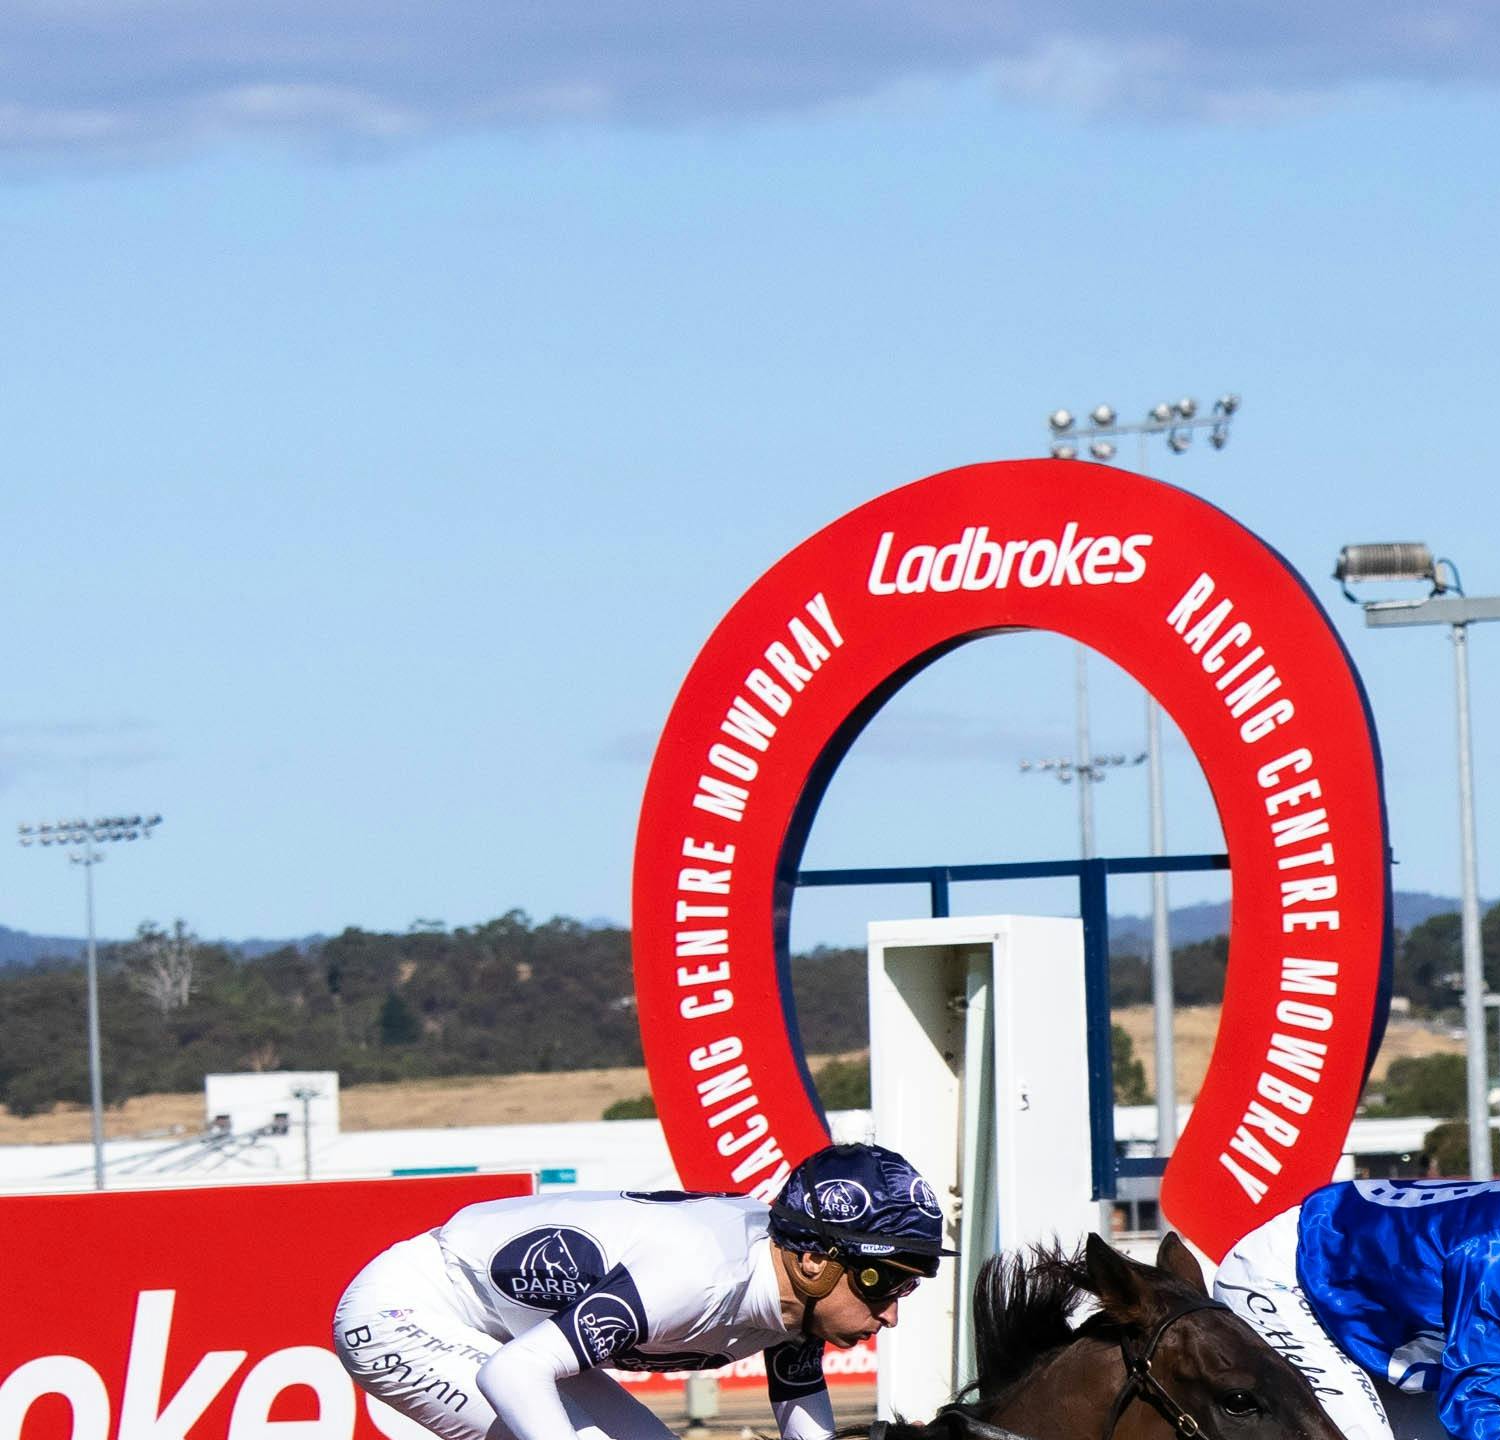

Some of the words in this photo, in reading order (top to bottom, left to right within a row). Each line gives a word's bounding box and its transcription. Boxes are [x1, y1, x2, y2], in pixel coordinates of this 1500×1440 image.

[869, 523, 1152, 595] Ladbrokes
[1167, 573, 1293, 742] RACING
[694, 593, 843, 821] MOWBRAY
[1258, 749, 1339, 932] CENTRE
[677, 838, 734, 1018] CENTRE
[1220, 958, 1338, 1203] MOWBRAY
[690, 1037, 792, 1202] RACING
[819, 1204, 859, 1214] ARBY
[512, 1277, 590, 1295] DARBY
[516, 1293, 578, 1301] RACIN
[344, 1324, 372, 1358] B.
[584, 1313, 610, 1360] DARB
[1352, 1368, 1388, 1425] TRACK
